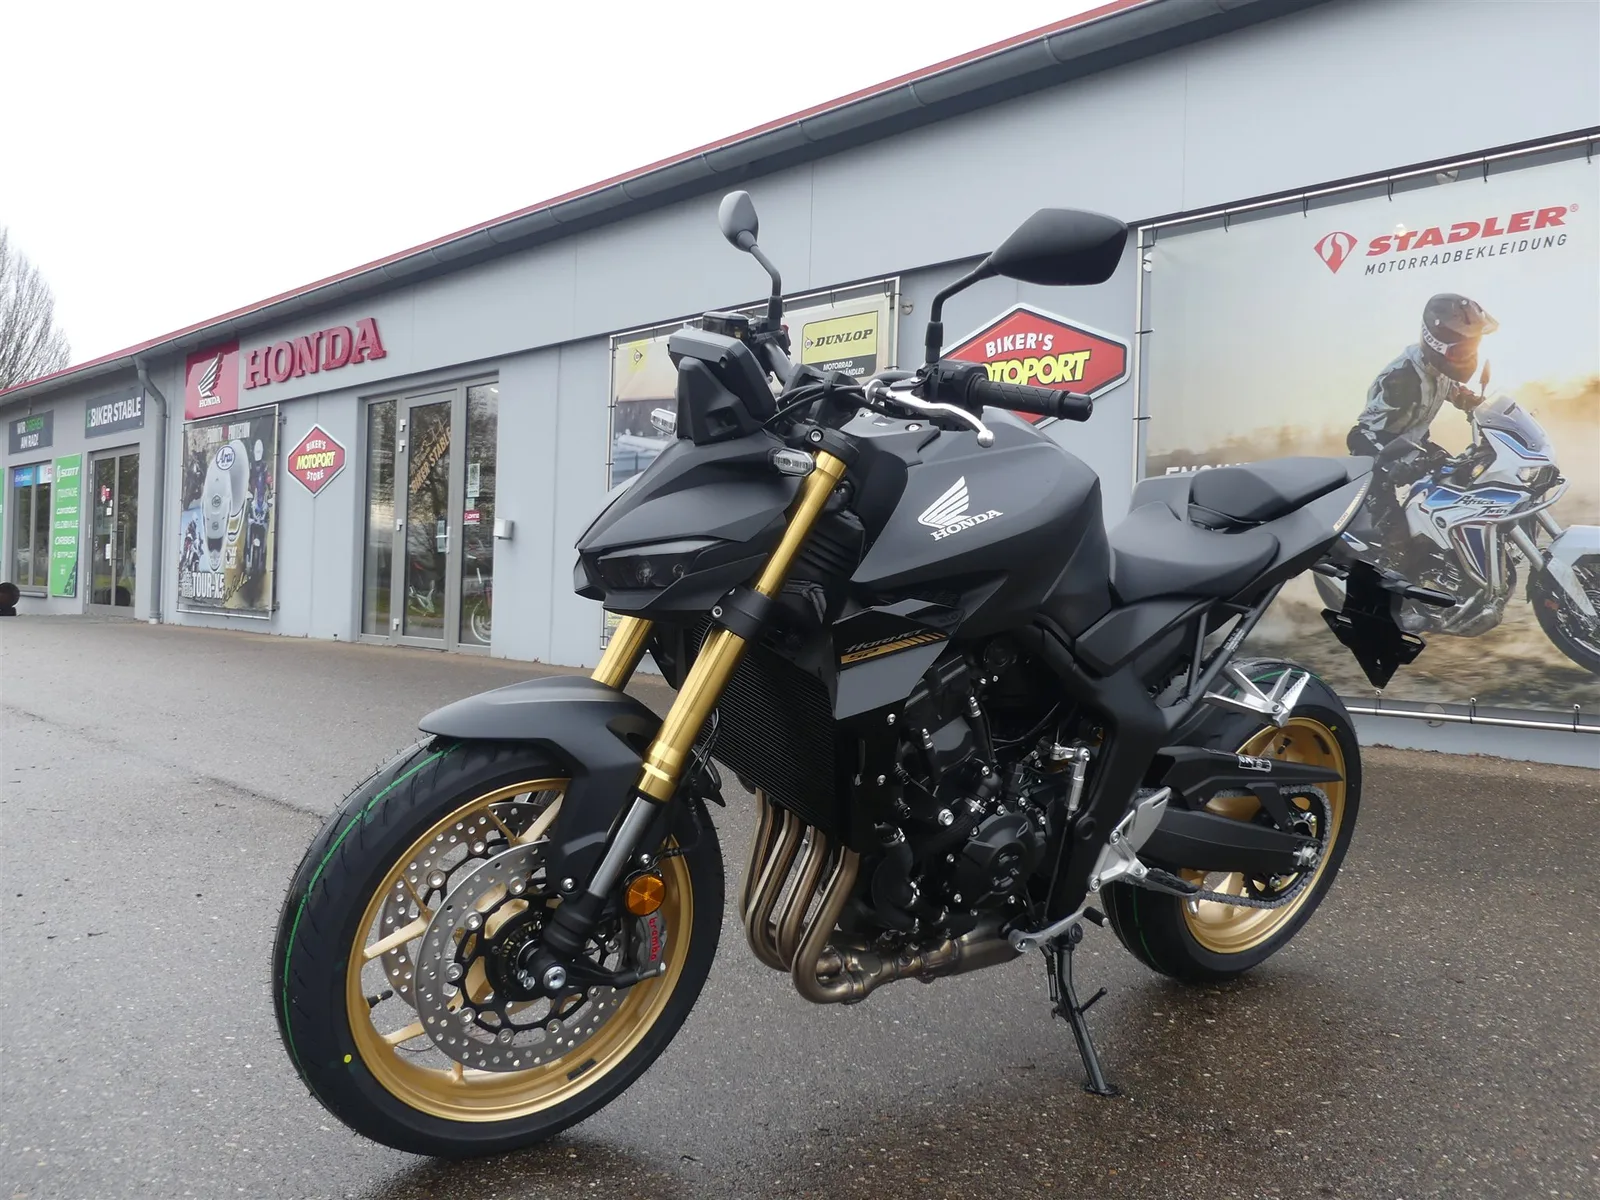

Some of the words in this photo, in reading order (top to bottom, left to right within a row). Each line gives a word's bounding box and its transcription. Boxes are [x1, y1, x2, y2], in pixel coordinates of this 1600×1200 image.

[1365, 206, 1567, 257] STADLER
[1364, 233, 1567, 276] MOTORRADBEKLEIDUNG
[814, 328, 873, 348] DUNLOP
[985, 332, 1054, 358] BIKER'S
[244, 317, 387, 390] HONDA
[822, 360, 853, 371] MOTORRAD
[113, 397, 141, 421] STABLE
[199, 396, 221, 408] HONDA
[306, 440, 326, 452] BIKER'S
[296, 451, 335, 470] MOTOPORT
[60, 466, 79, 478] SCOTT
[306, 469, 324, 481] STORE
[1453, 495, 1495, 505] Africa
[1478, 506, 1507, 516] Twin
[930, 509, 1003, 541] HONDA
[54, 536, 75, 545] ORBEA
[649, 917, 661, 961] brembo
